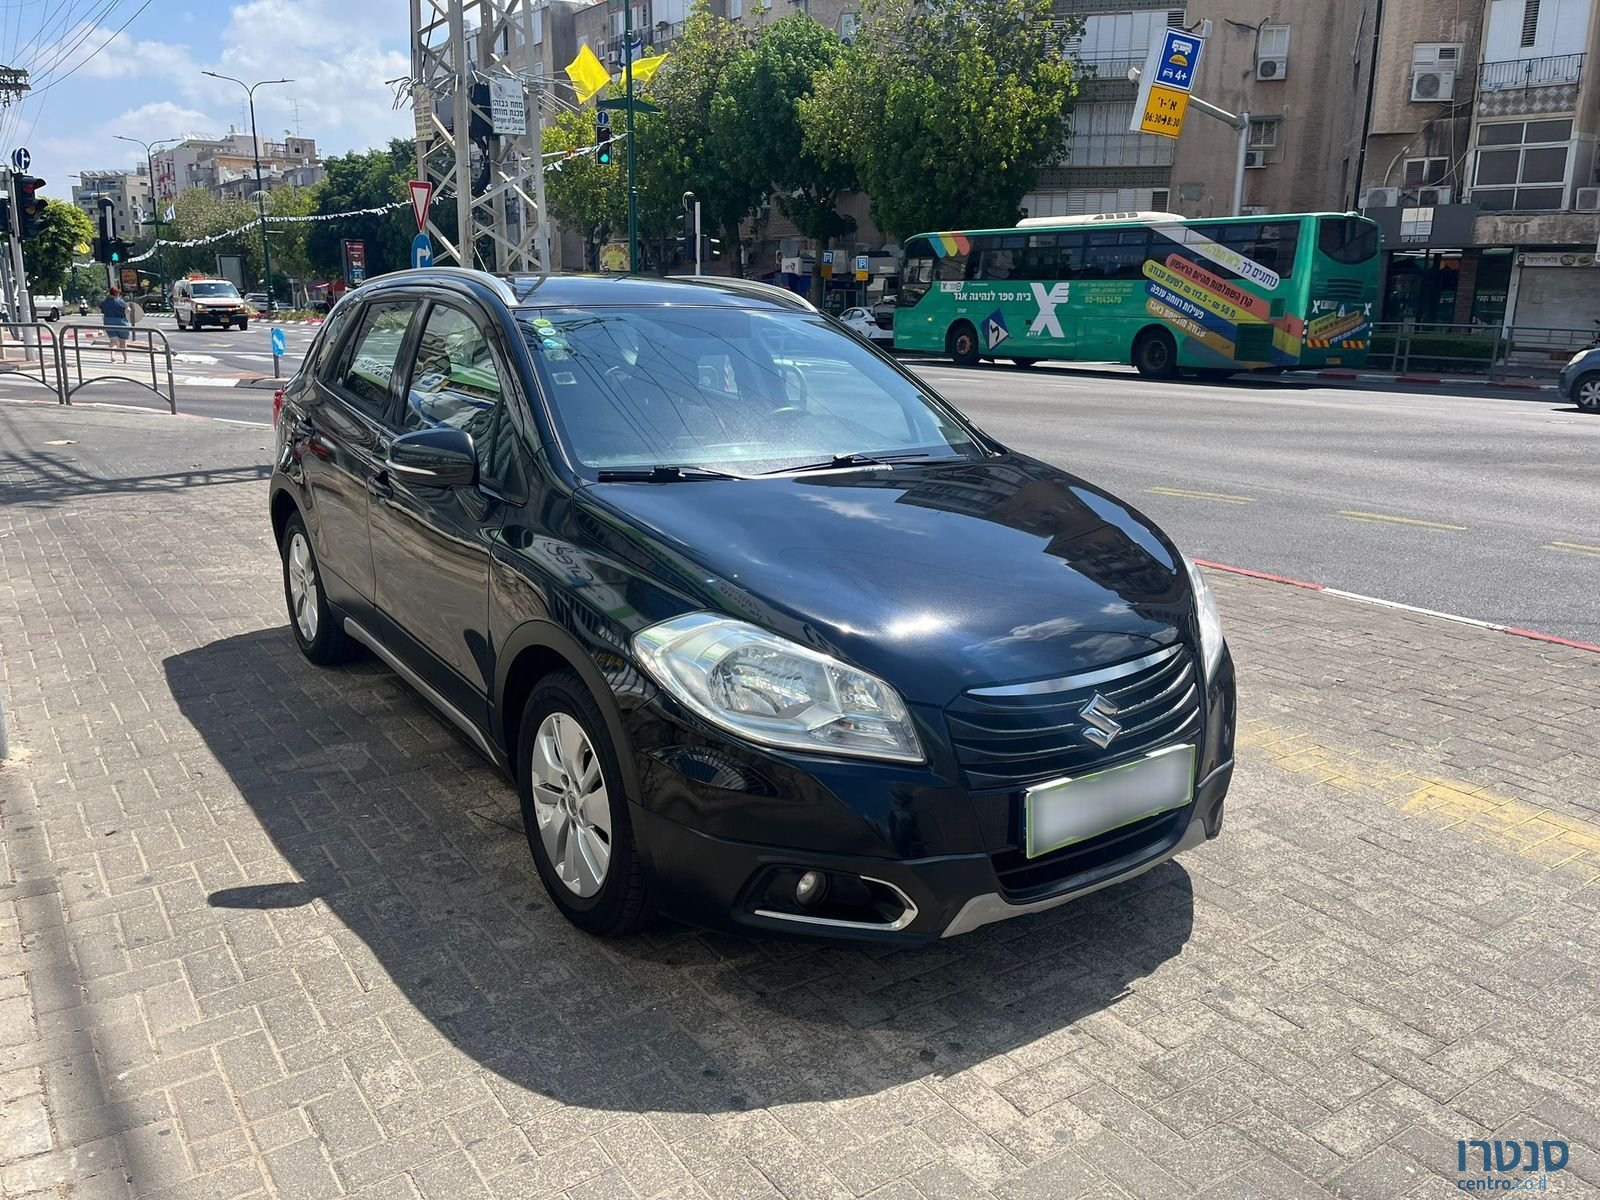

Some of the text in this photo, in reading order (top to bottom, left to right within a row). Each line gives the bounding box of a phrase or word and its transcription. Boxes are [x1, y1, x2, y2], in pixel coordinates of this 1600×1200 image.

[1175, 69, 1187, 81] 4+
[510, 101, 523, 109] מתח
[509, 109, 524, 117] סכנת
[1148, 263, 1166, 281] עבודה
[1251, 269, 1278, 288] נותנים
[1166, 272, 1184, 289] לשעת
[1170, 257, 1254, 308] קרן השתלמות מהיום הראשון
[953, 290, 1031, 301] בית ספר לנהיגה אגד
[1150, 283, 1205, 320] פעילות רווחה ענפה
[1149, 300, 1165, 314] באגד
[1220, 304, 1230, 315] 50
[1186, 321, 1206, 338] עבודה
